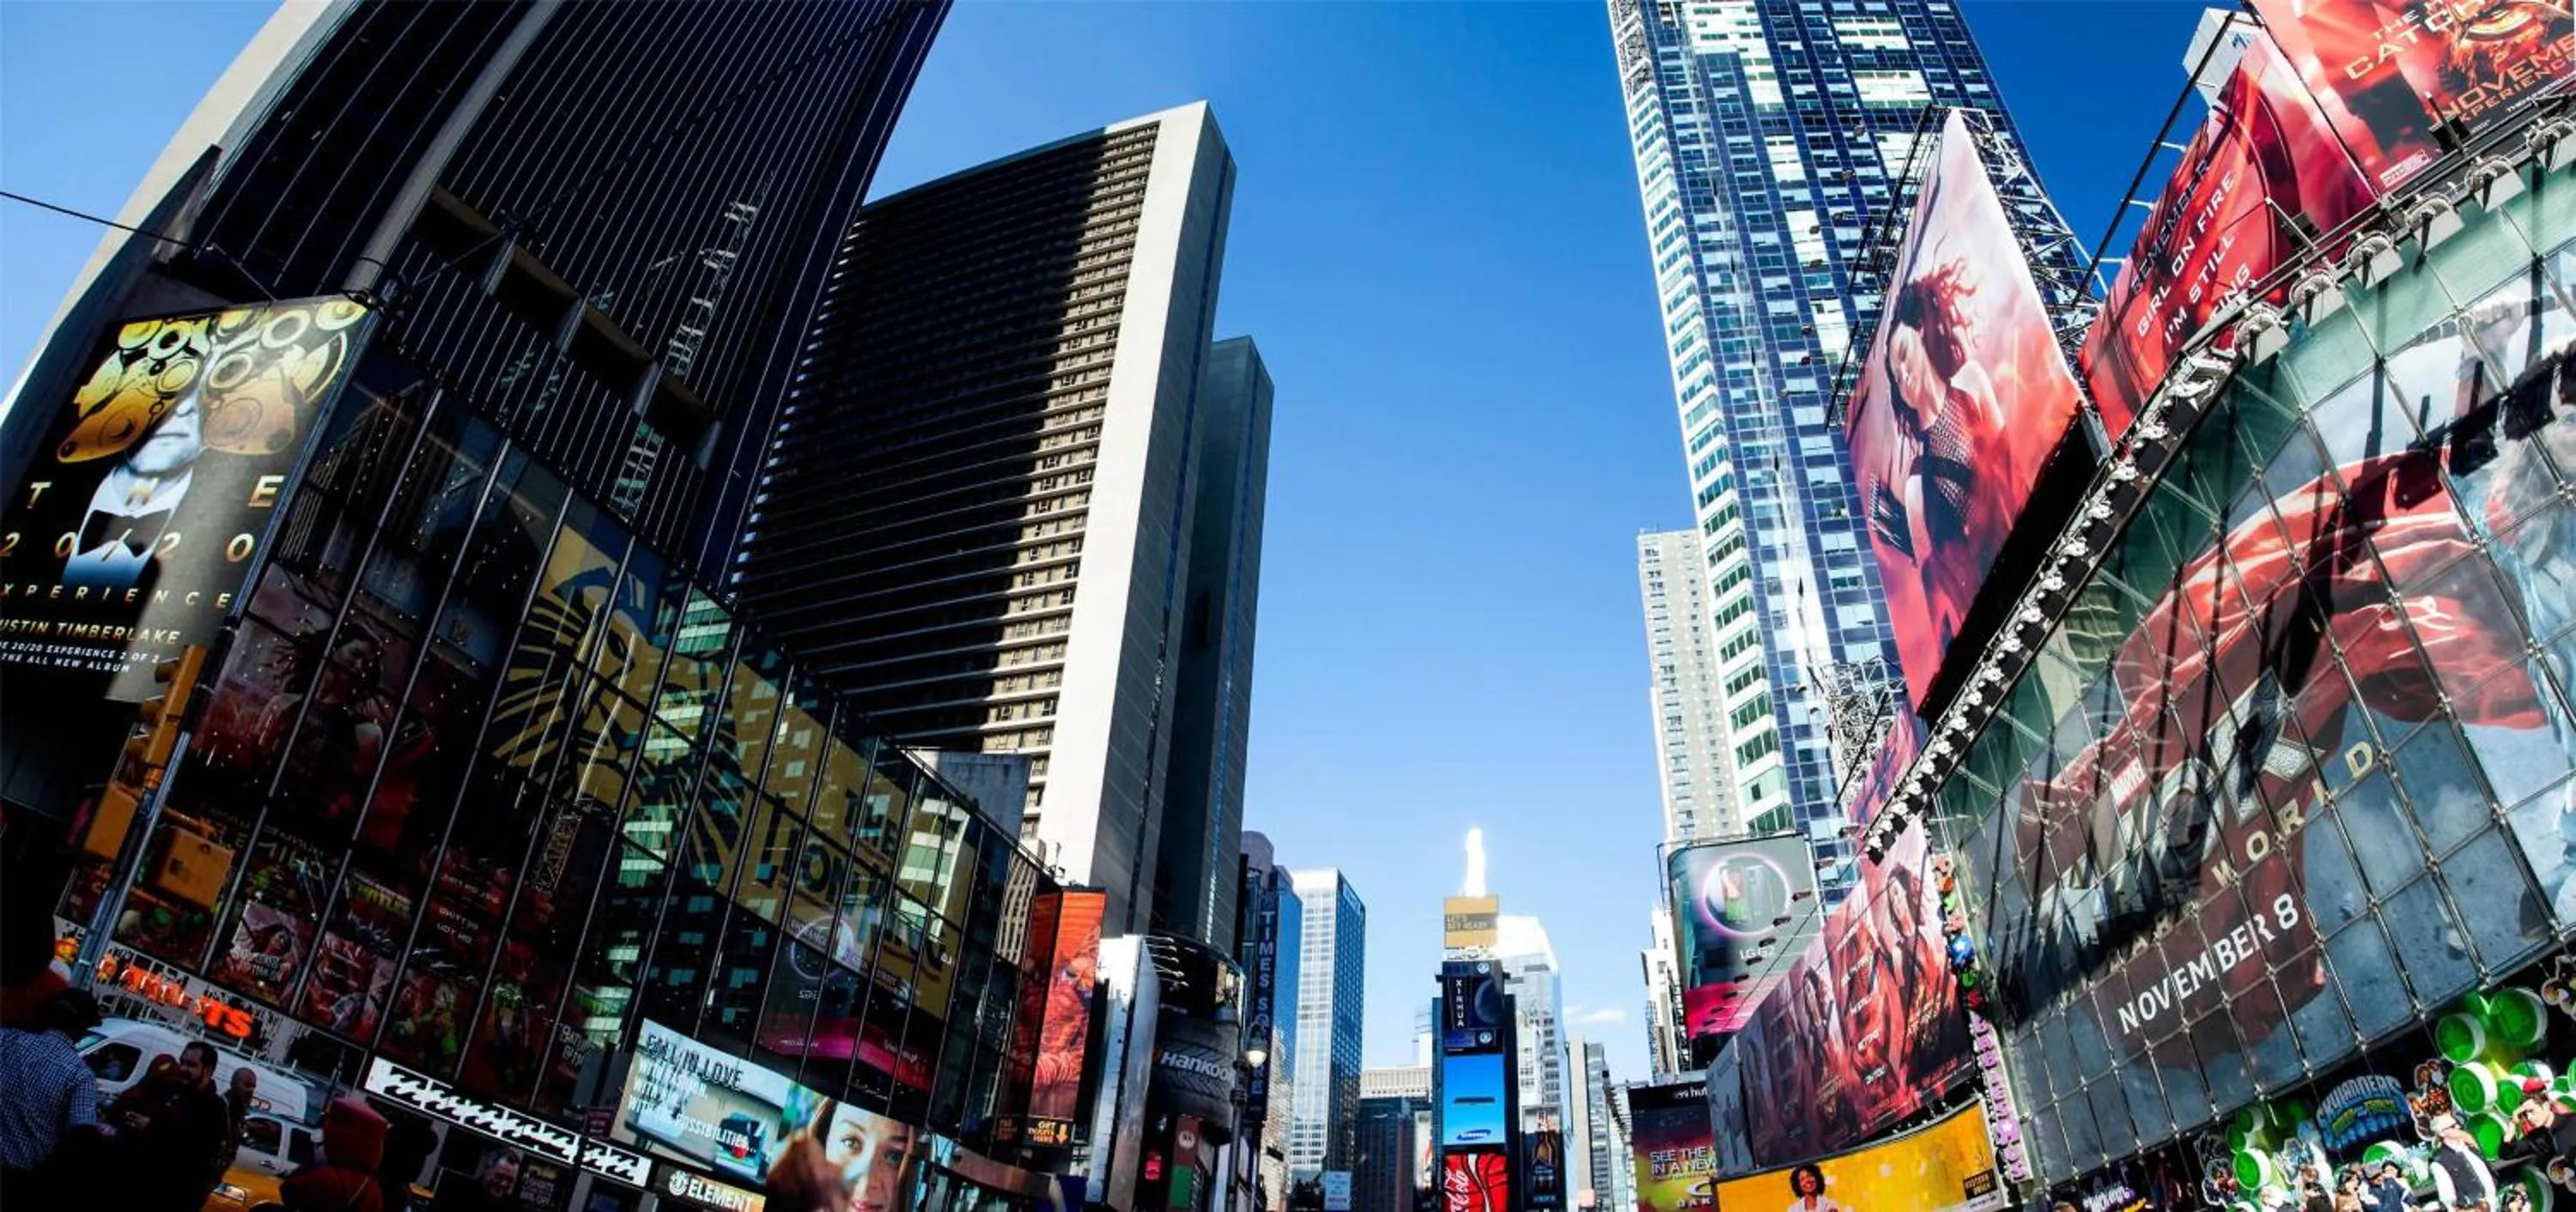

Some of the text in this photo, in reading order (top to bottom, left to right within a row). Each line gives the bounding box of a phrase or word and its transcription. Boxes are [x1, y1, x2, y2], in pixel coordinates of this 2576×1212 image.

[2137, 171, 2235, 336] GIRL ON FIRE
[2165, 233, 2235, 344] I'M STILL
[0, 583, 231, 609] XPERIENCE
[0, 618, 181, 644] USTIN TIMBERLAKE
[27, 654, 47, 665] ALL
[55, 658, 82, 668] NEW
[87, 662, 131, 673] ALBUM
[46, 645, 115, 659] EXPERIENCE
[131, 653, 149, 663] OF
[2117, 914, 2275, 1035] NOVEMBER
[2273, 894, 2300, 930] 8
[1250, 910, 1276, 1094] TIMES SQRE
[702, 1057, 745, 1091] LOVE
[1160, 1051, 1230, 1081] Hankoo
[1649, 1150, 1677, 1163] SEE
[1680, 1146, 1707, 1160] THE
[687, 1178, 754, 1212] ELEMENT
